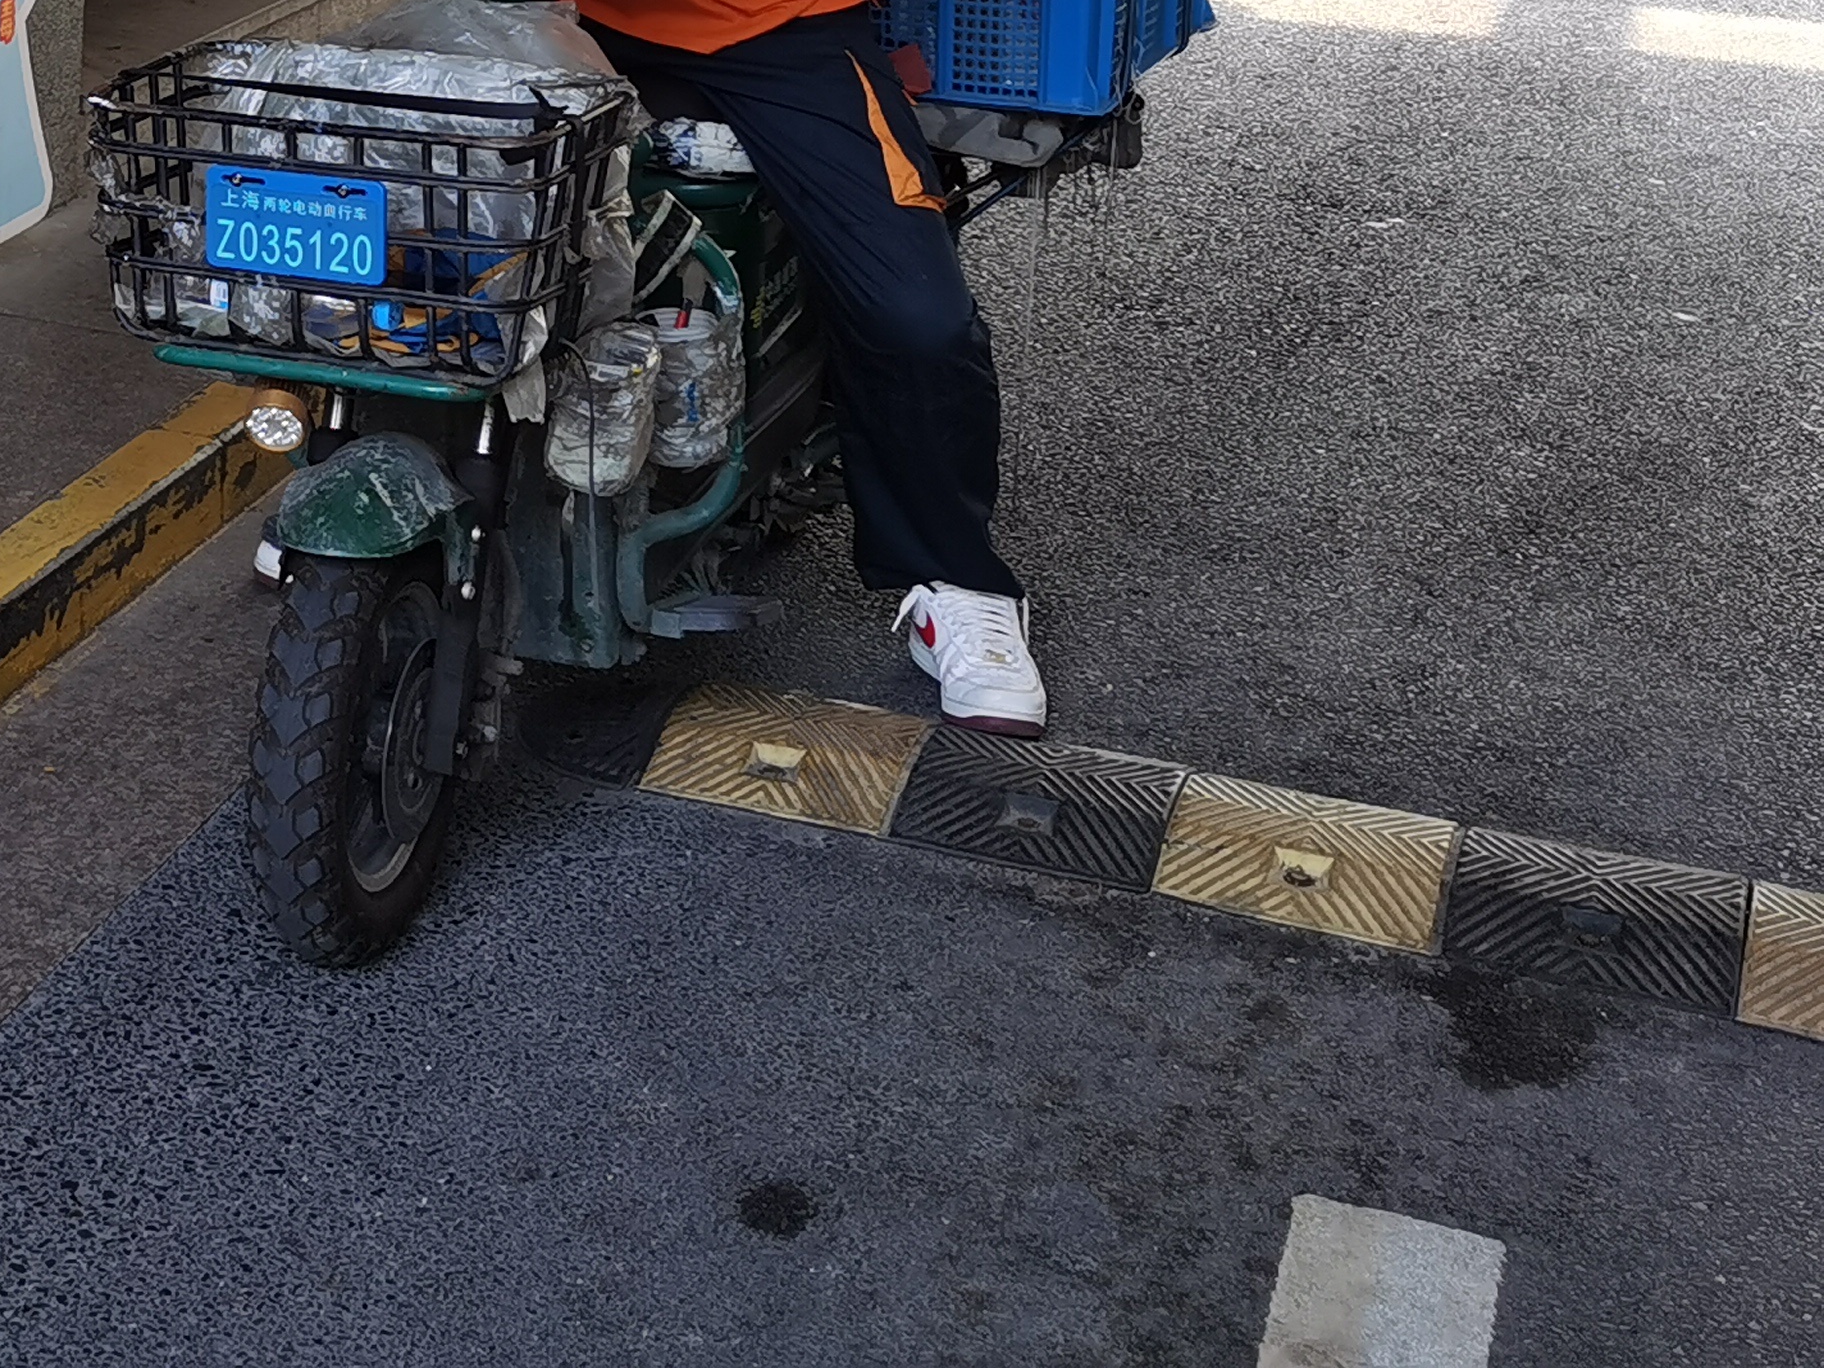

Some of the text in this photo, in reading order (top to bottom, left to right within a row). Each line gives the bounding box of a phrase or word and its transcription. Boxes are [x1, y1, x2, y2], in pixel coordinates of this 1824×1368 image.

[221, 188, 368, 222] 上海 两轮电动自行车
[215, 217, 373, 277] Z035120
